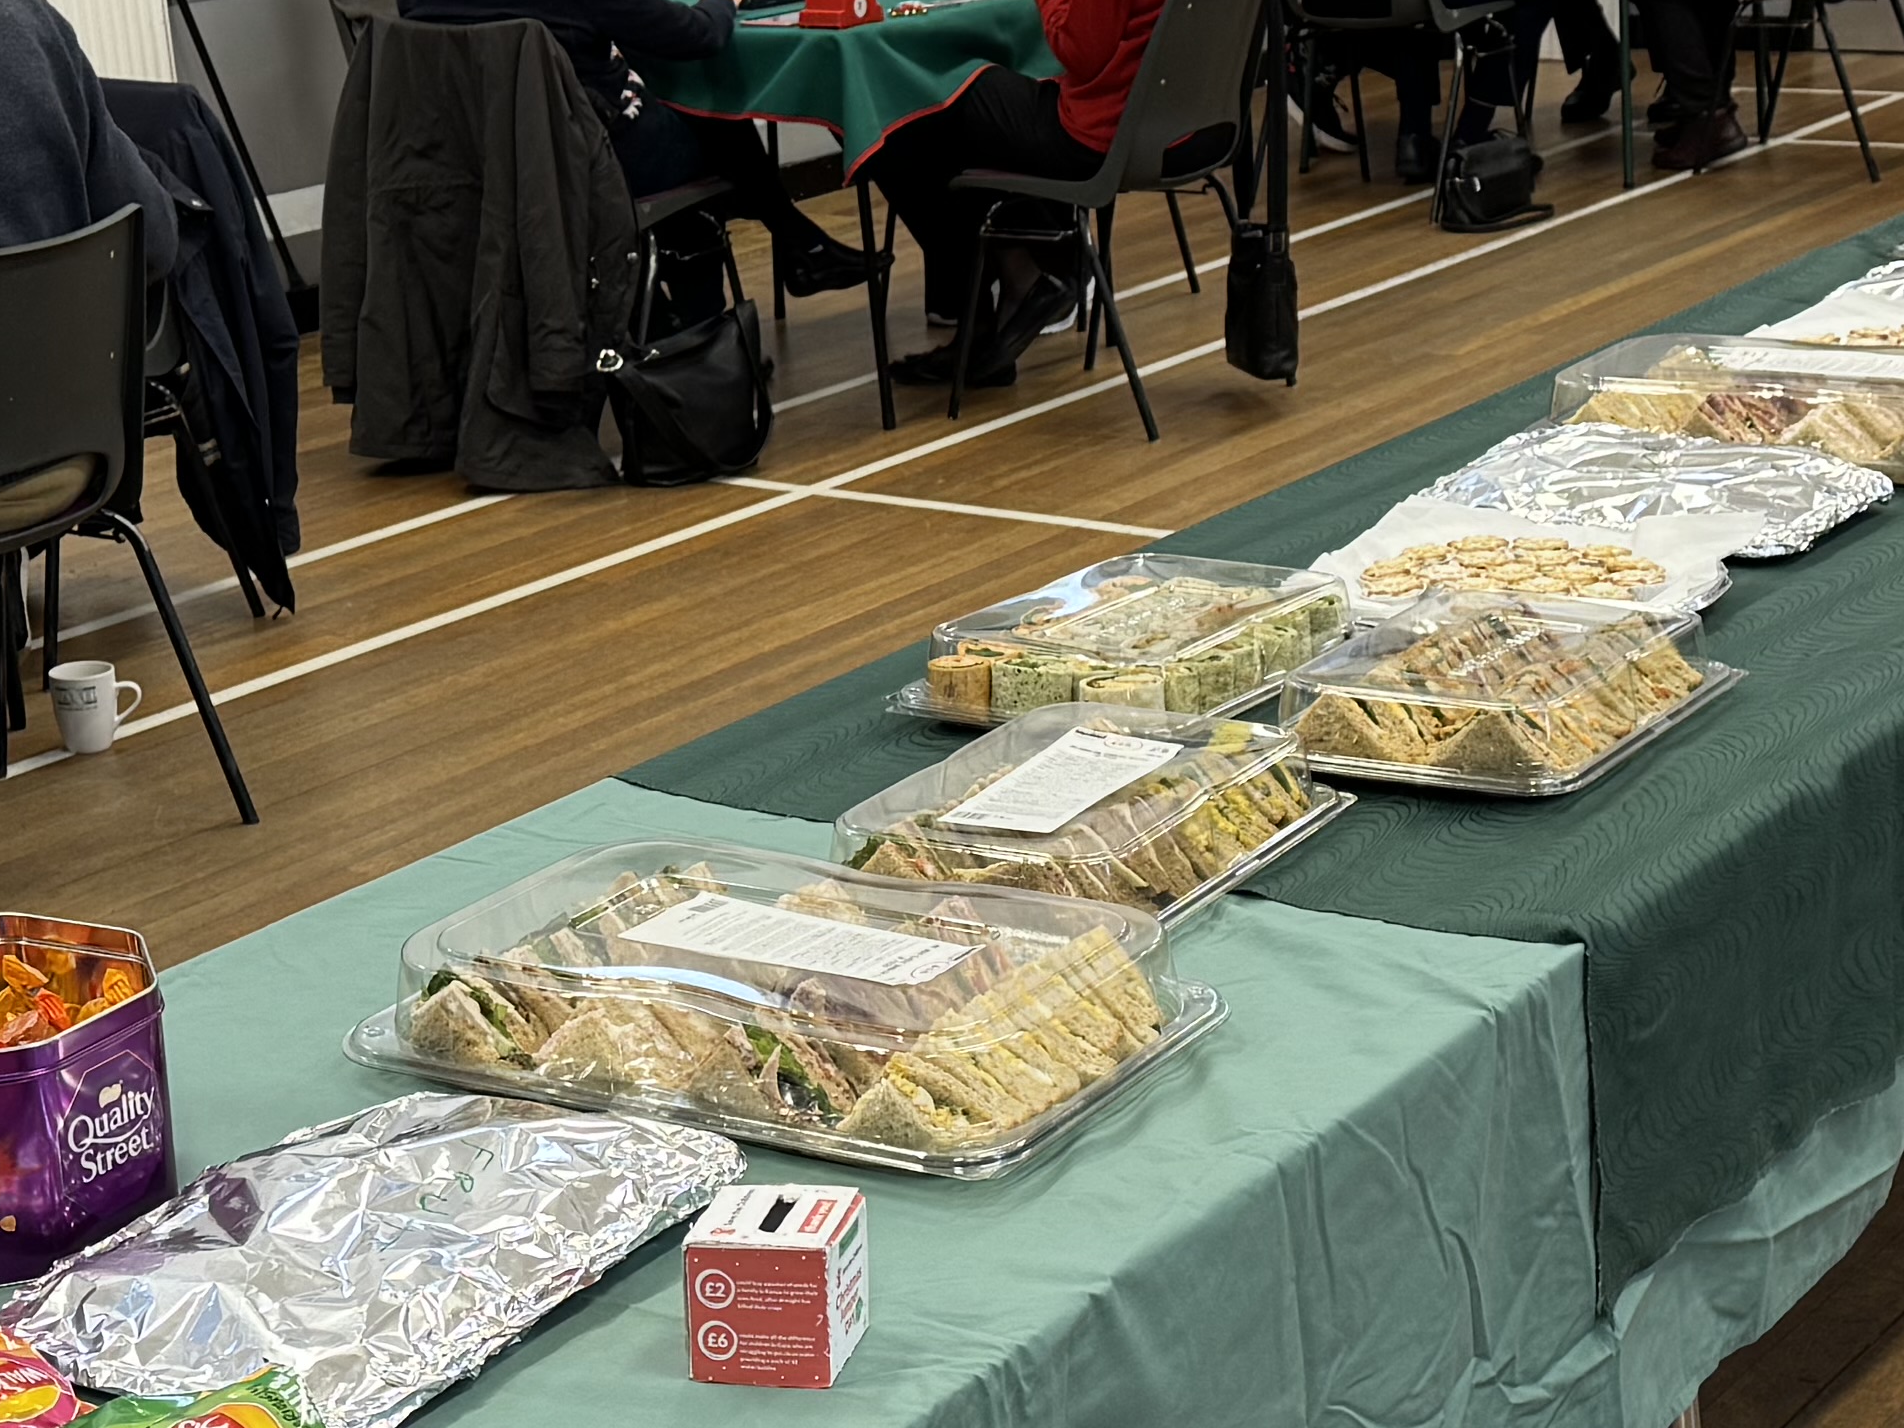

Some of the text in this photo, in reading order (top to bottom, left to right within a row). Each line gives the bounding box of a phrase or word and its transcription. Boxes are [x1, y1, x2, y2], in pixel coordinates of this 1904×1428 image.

[67, 1085, 156, 1153] Quality
[80, 1125, 154, 1185] Street
[704, 1281, 726, 1298] £2
[707, 1332, 729, 1348] £6
